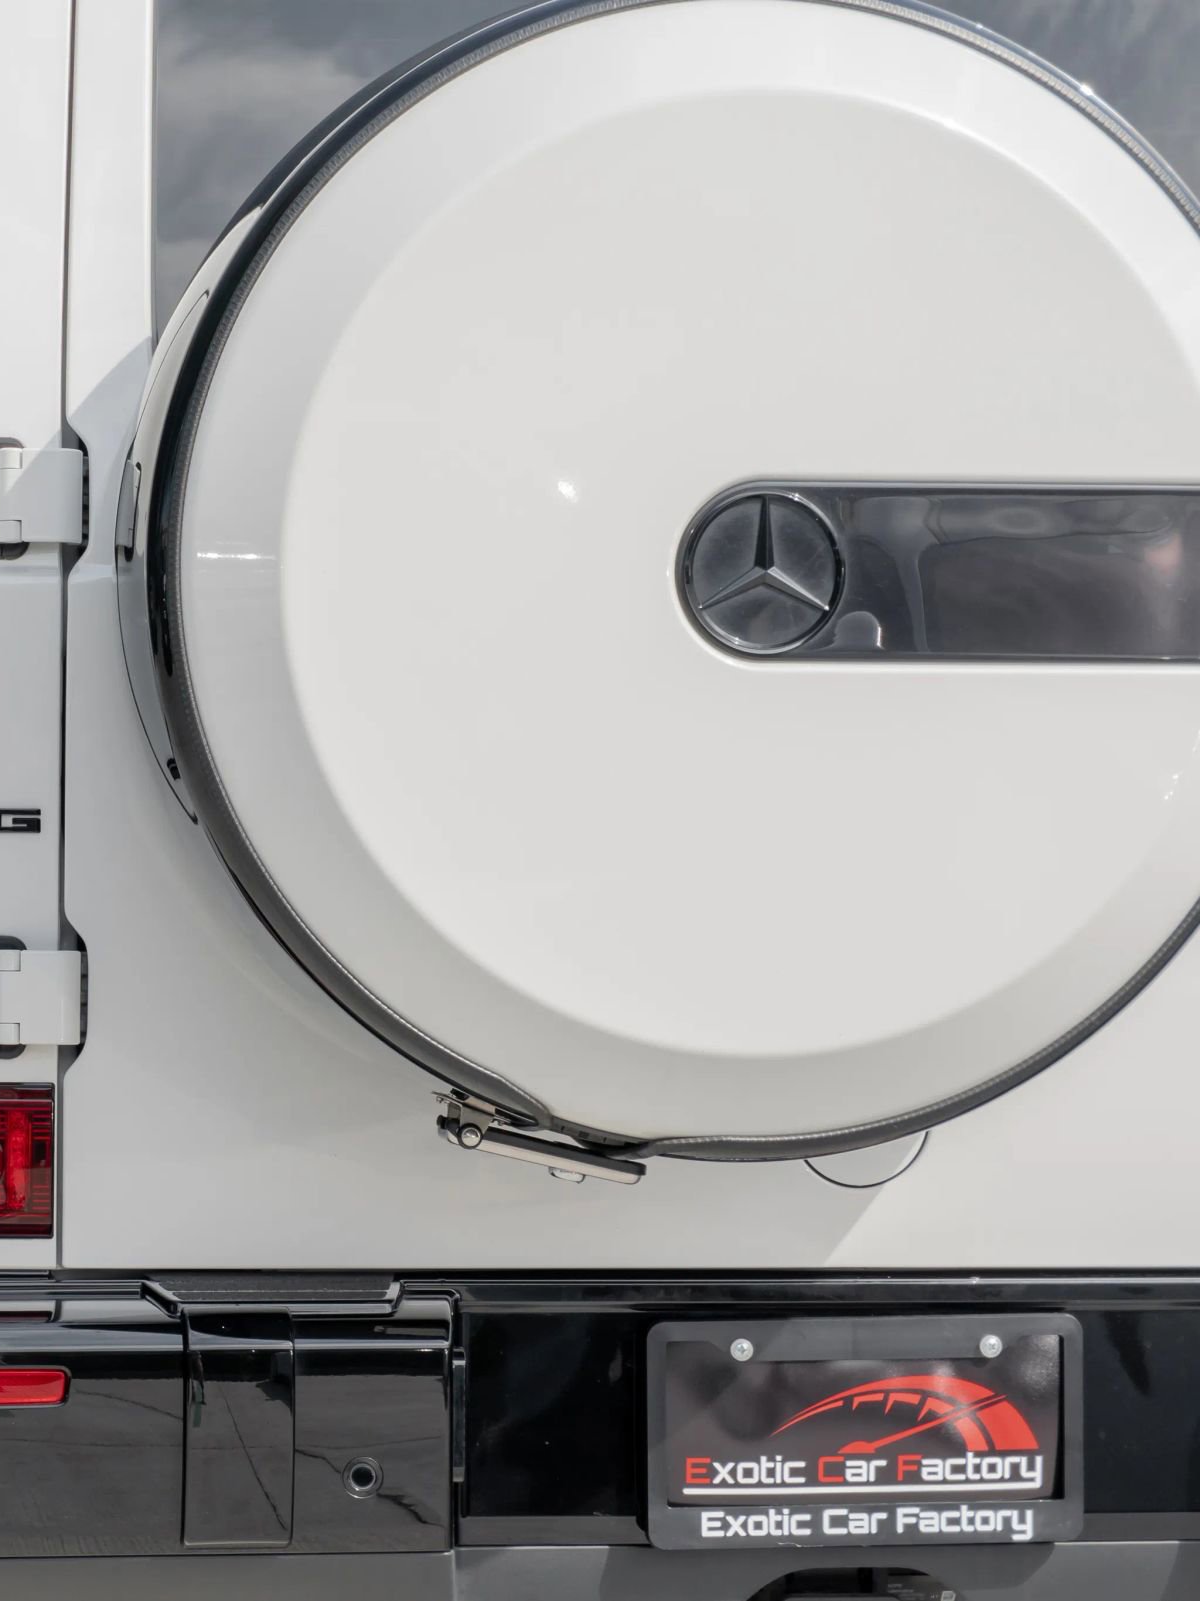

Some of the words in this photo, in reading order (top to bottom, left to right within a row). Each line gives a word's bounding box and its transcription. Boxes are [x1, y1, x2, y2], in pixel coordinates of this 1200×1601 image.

[685, 1455, 806, 1485] Exotic
[817, 1456, 888, 1483] Car
[897, 1452, 1043, 1488] Factory
[701, 1509, 812, 1538] Exotic
[822, 1509, 888, 1535] Car
[895, 1505, 1034, 1541] Factory
